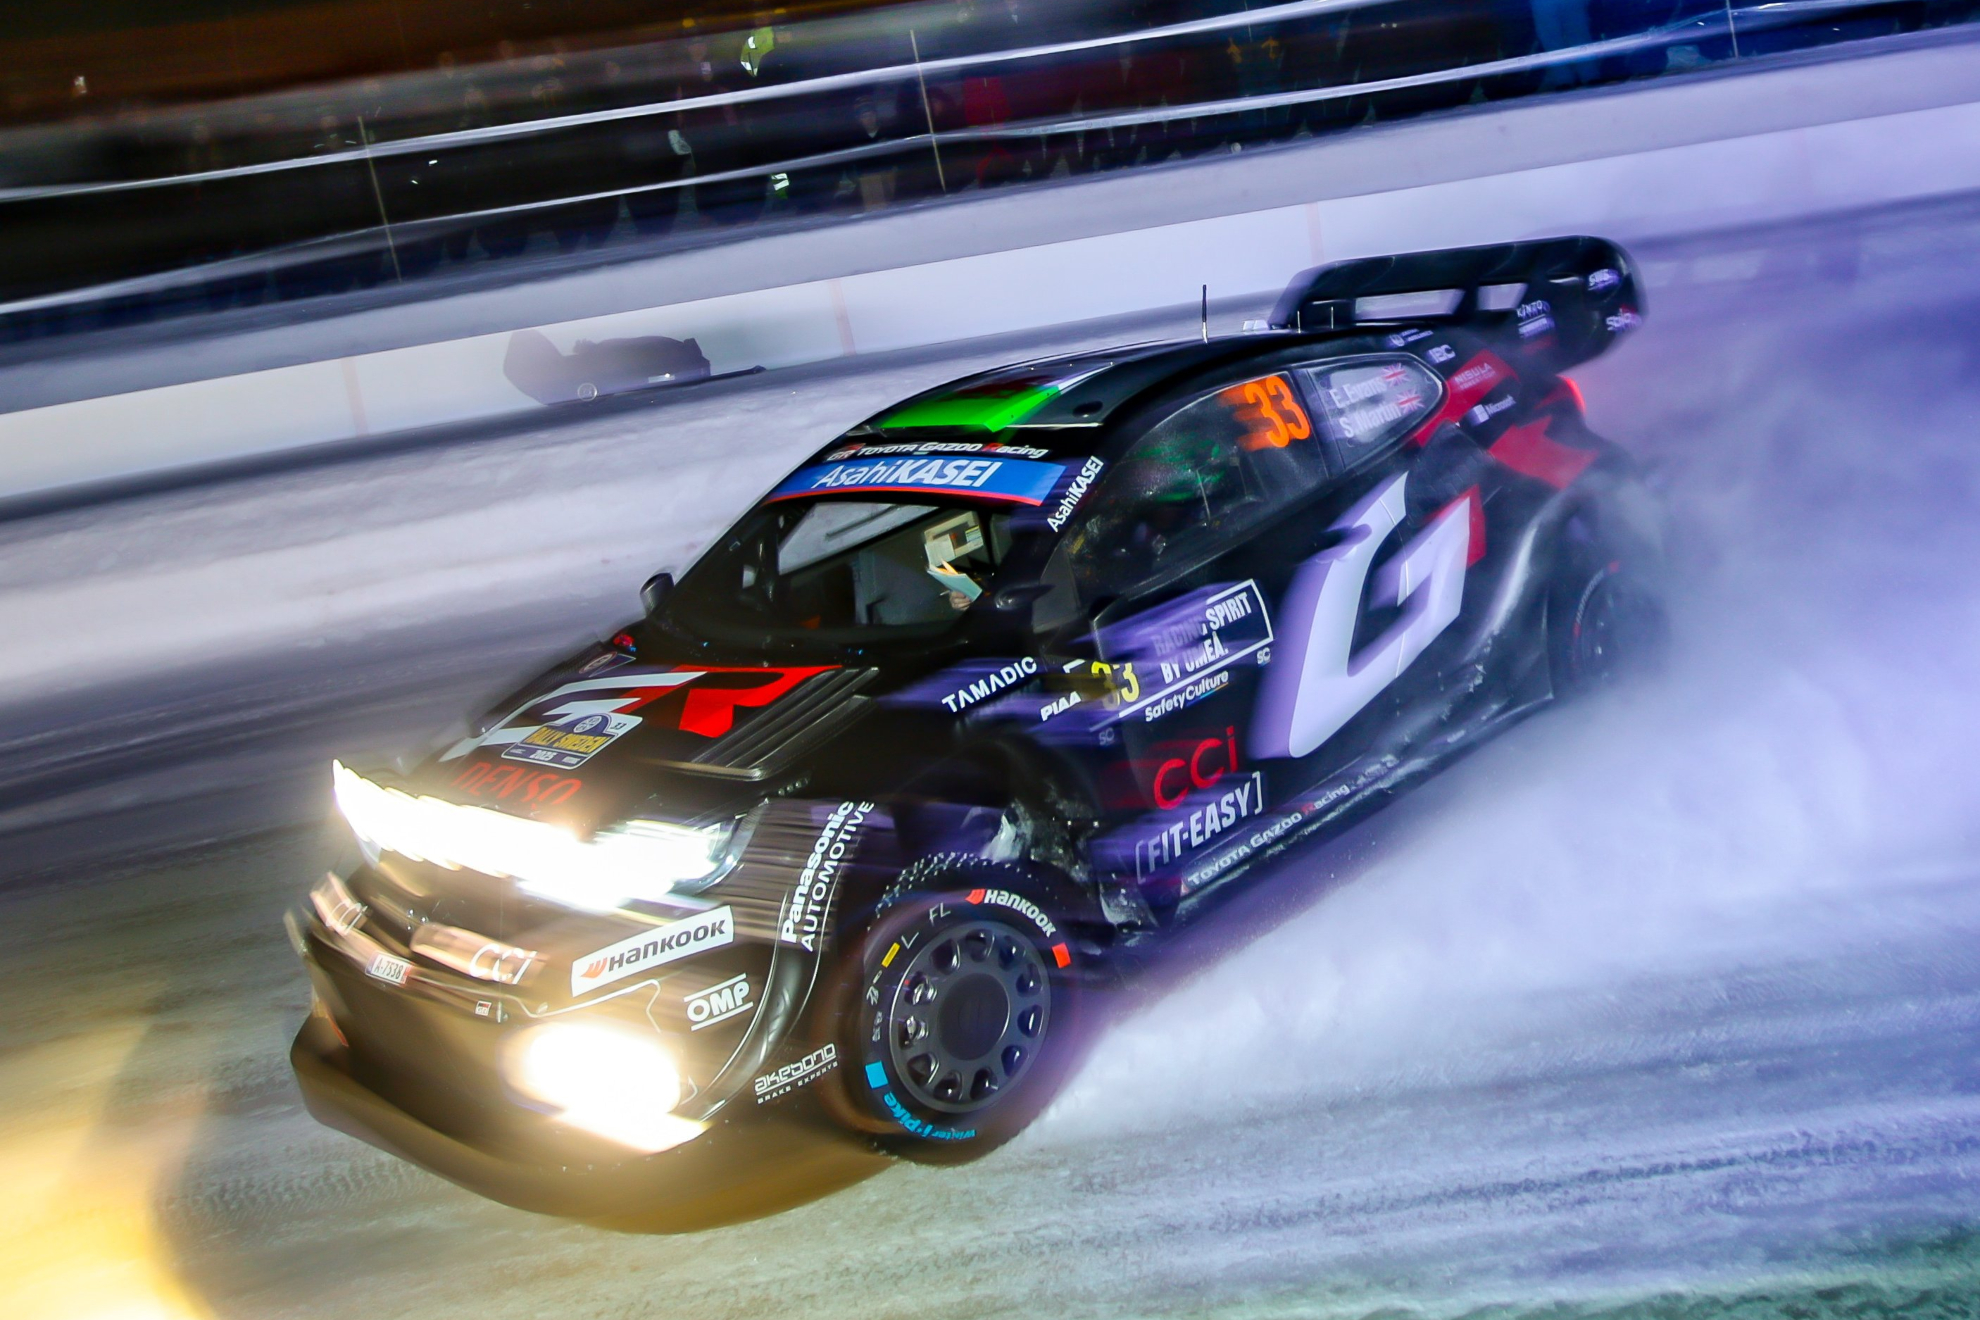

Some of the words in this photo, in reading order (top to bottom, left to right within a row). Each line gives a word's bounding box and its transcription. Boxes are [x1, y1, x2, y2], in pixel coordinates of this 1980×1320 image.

[1243, 375, 1310, 448] 33
[811, 459, 1003, 489] AsahiKASEI
[857, 444, 914, 457] TOYOTA
[918, 442, 982, 453] GAZOO
[981, 442, 1049, 459] Racing
[1046, 455, 1104, 533] AsahiKASEI
[1205, 591, 1252, 631] SPIRIT
[941, 656, 1037, 713] TAMADIC
[1160, 656, 1182, 685] BY
[1040, 690, 1082, 722] PIAA
[1145, 670, 1229, 723] SafetyCulture
[523, 725, 567, 747] RALLY
[552, 732, 613, 755] SWEDEN
[450, 761, 582, 811] DENSO
[1187, 844, 1250, 886] TOYOTA
[1249, 811, 1303, 848] GAZOO
[1301, 783, 1351, 817] Racing
[781, 800, 854, 944] Panasonic
[799, 800, 876, 952] AUTOMOTIVE
[685, 980, 751, 1023] OMP
[757, 1085, 792, 1105] BRAKE
[797, 1060, 839, 1087] EXPERTS
